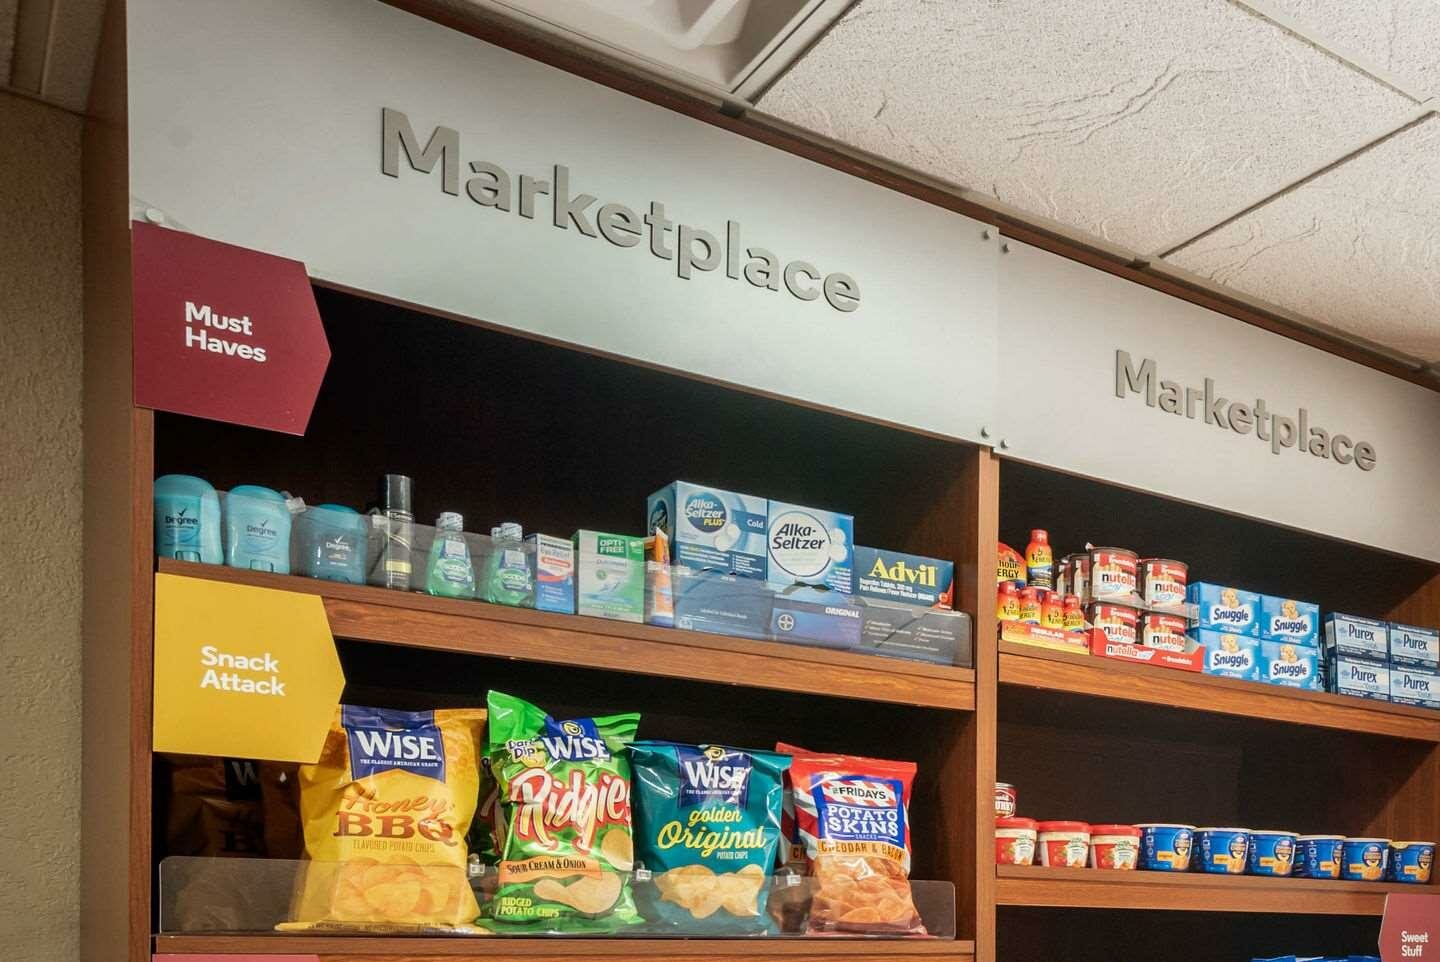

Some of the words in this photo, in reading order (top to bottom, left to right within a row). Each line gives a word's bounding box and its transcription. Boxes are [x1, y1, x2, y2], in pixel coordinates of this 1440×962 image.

[379, 106, 861, 314] Marketplace
[184, 301, 252, 336] Must
[184, 327, 267, 363] Haves
[1115, 349, 1377, 471] Marketplace
[689, 498, 717, 509] Alka-
[686, 506, 724, 518] Seltzer
[165, 515, 199, 525] Degree
[703, 518, 723, 527] PLUS
[746, 519, 764, 529] Cold
[247, 525, 278, 536] Degree
[776, 523, 817, 537] Alka-
[599, 538, 624, 547] OPTI-
[599, 545, 625, 554] FREE
[772, 536, 826, 550] Seltzer
[867, 557, 936, 587] Advil
[997, 568, 1019, 578] ERGY
[825, 606, 860, 618] ORIGINAL
[1213, 608, 1249, 623] Snuggle
[1273, 619, 1308, 634] Snuggle
[1348, 623, 1375, 641] Purex
[1403, 634, 1428, 651] Purex
[1107, 645, 1138, 657] nutella
[200, 645, 279, 674] Snack
[1213, 653, 1249, 668] Snuggle
[1272, 662, 1308, 678] Snuggle
[1351, 666, 1377, 683] Purex
[200, 669, 286, 697] Attack
[1403, 674, 1430, 691] Purex
[355, 730, 437, 760] WISE
[541, 735, 611, 761] WISE
[513, 747, 536, 761] Dip
[685, 761, 746, 789] WISE
[839, 787, 887, 800] FRIDAYS
[343, 795, 448, 820] Honey
[827, 805, 898, 822] POTATO
[687, 807, 743, 827] golden
[333, 811, 458, 847] BBQ
[829, 817, 899, 837] SKINS
[353, 840, 388, 851] FLAVORED
[657, 820, 767, 858] Original
[556, 859, 562, 869] &
[502, 897, 532, 906] RIDGED
[501, 905, 534, 916] POTATO
[536, 907, 560, 918] CHIPS
[1401, 931, 1429, 943] Sweet
[1401, 944, 1423, 957] Stuff
